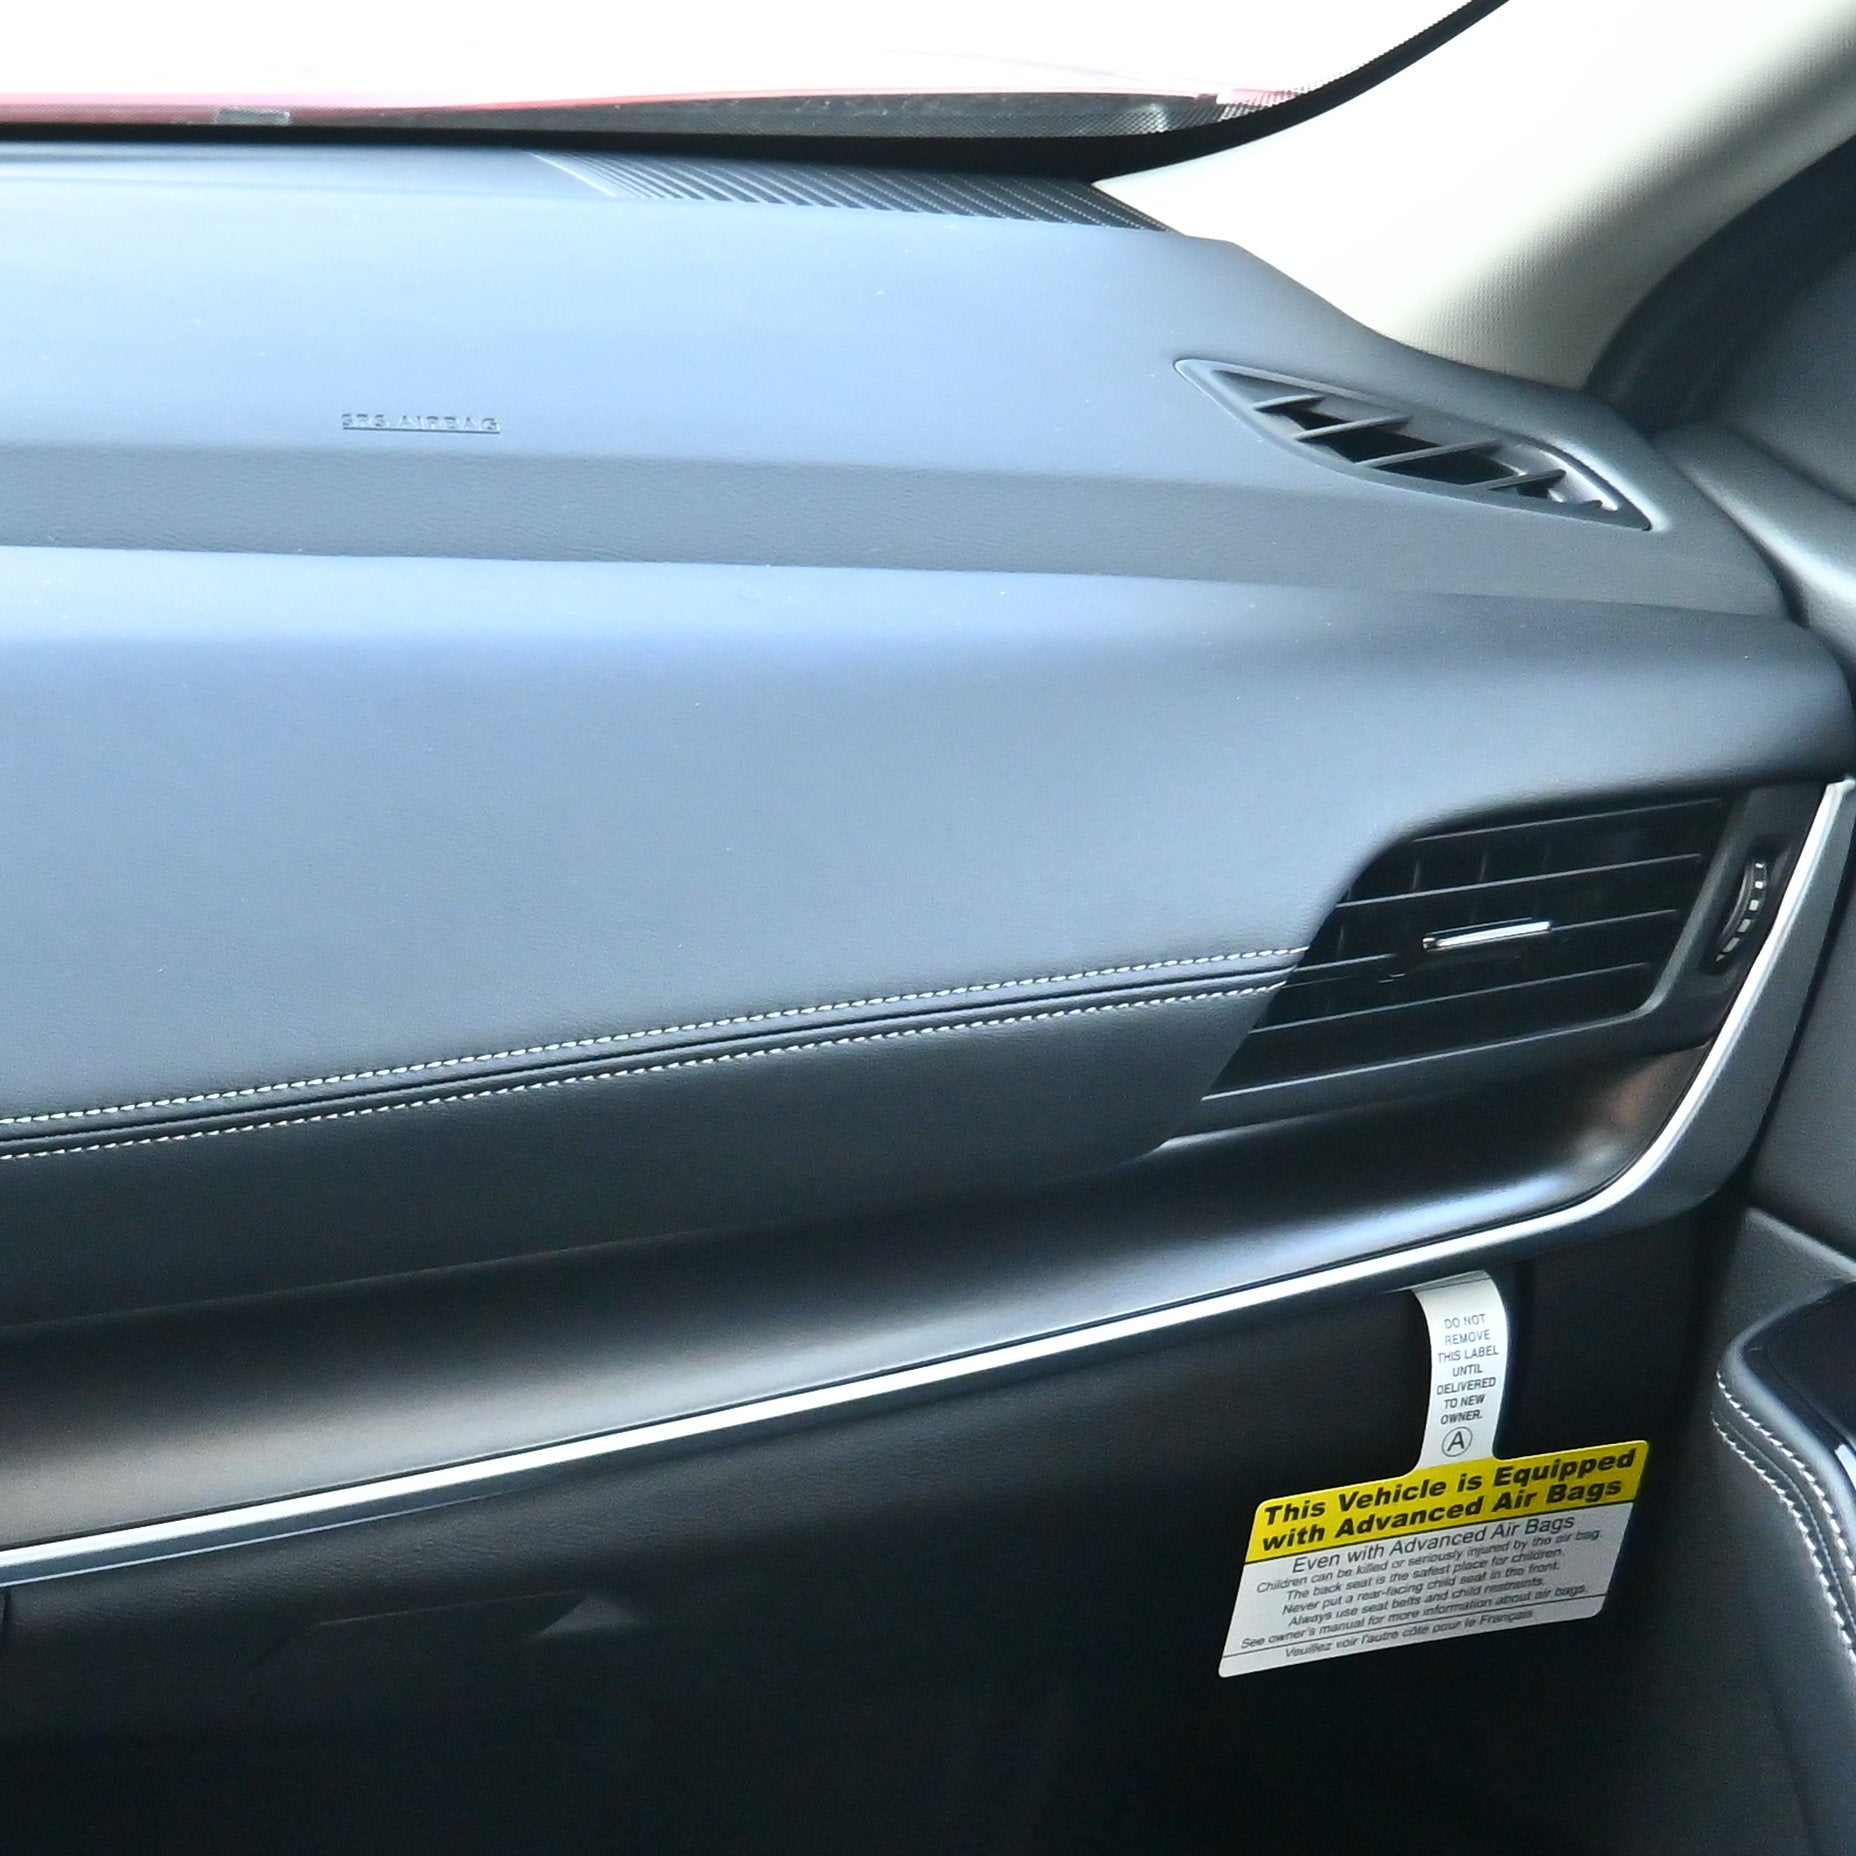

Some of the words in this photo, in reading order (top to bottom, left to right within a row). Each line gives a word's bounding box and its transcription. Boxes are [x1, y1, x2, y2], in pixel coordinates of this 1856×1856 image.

[1444, 1318, 1460, 1329] DO
[1464, 1314, 1486, 1326] NOT
[1445, 1329, 1491, 1346] REMOVE
[1438, 1350, 1461, 1363] THIS
[1464, 1345, 1499, 1359] LABEL
[1452, 1363, 1483, 1377] UNTIL
[1436, 1377, 1496, 1395] DELIVERED
[1444, 1398, 1458, 1409] TO
[1460, 1394, 1486, 1407] NEW
[1264, 1499, 1326, 1526] This
[1338, 1479, 1447, 1512] Vehicle
[1457, 1473, 1482, 1493] is
[1493, 1448, 1637, 1487] Equipped
[1262, 1524, 1326, 1551] with
[1335, 1496, 1485, 1538] Advanced
[1492, 1491, 1538, 1512] Air
[1545, 1479, 1622, 1504] Bags
[1292, 1553, 1339, 1574] Even
[1347, 1543, 1385, 1563] with
[1389, 1526, 1487, 1557] Advanced
[1490, 1522, 1520, 1540] Air
[1524, 1516, 1575, 1535] Bags
